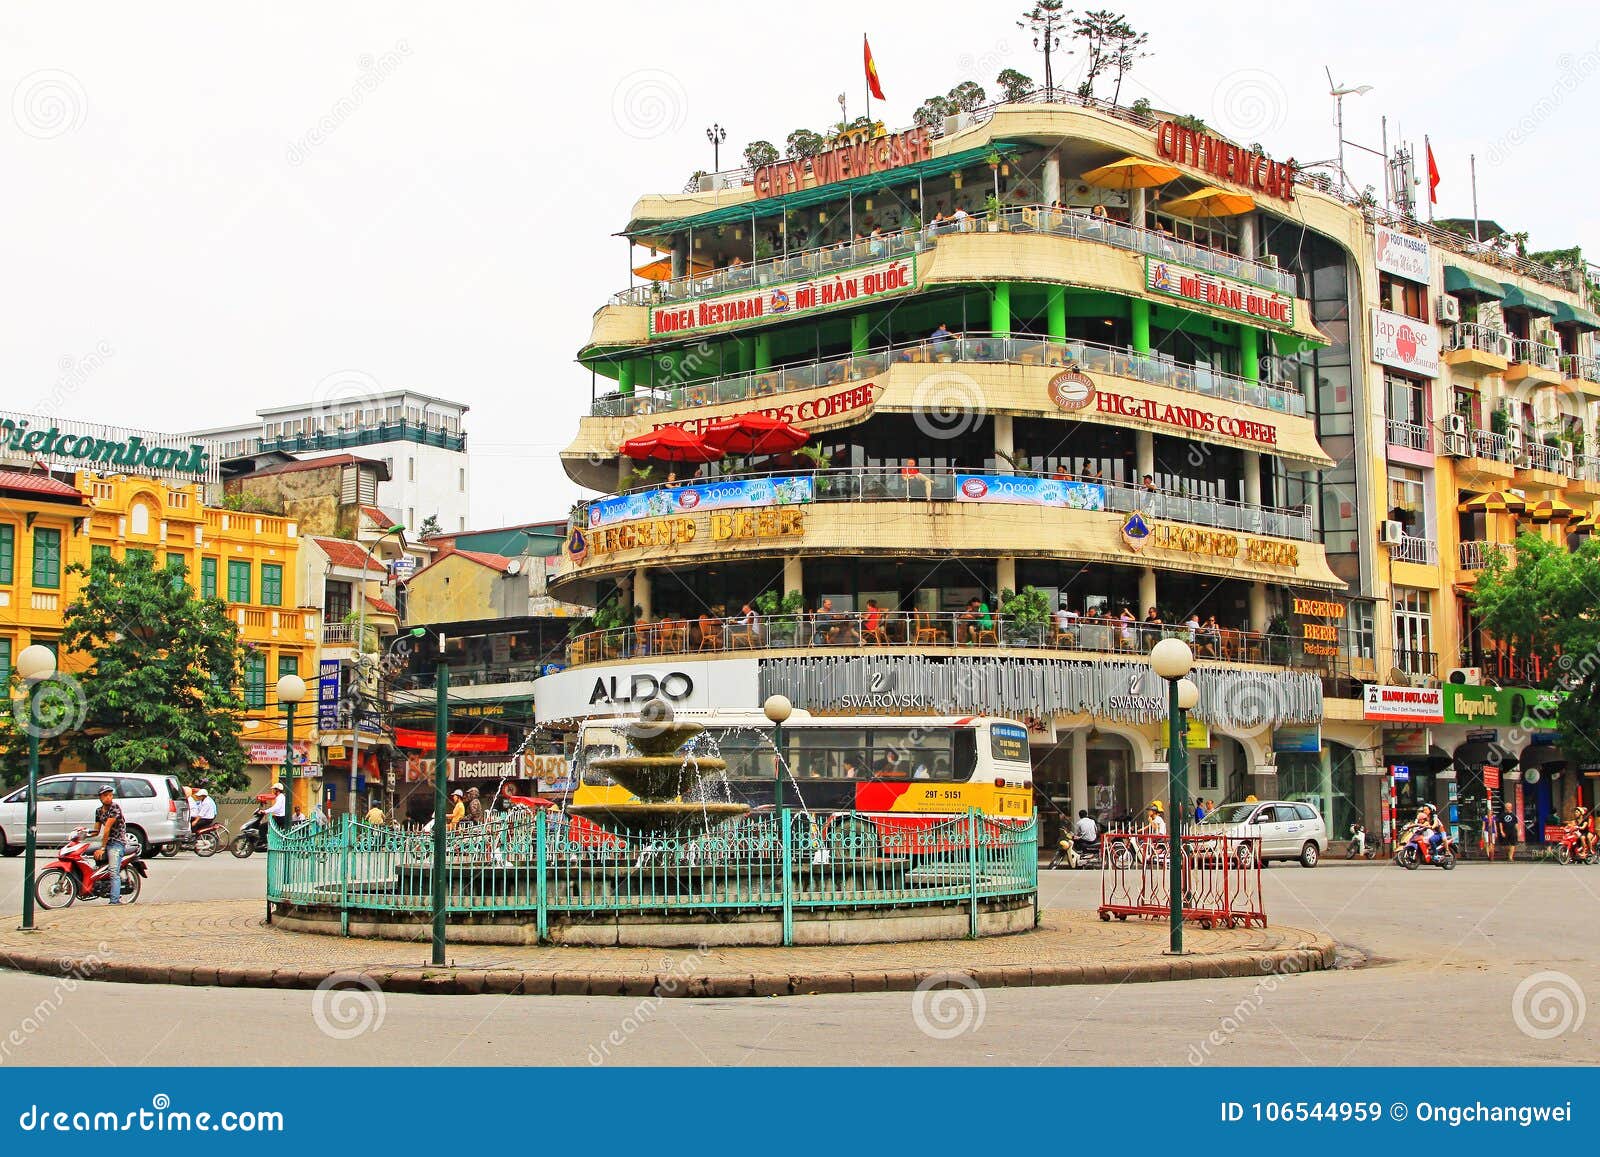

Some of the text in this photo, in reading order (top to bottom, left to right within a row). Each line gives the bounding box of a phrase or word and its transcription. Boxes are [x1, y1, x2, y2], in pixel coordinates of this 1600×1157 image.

[1157, 121, 1201, 169] CITY
[1203, 135, 1252, 188] VIEW
[753, 156, 811, 200] CITY
[810, 142, 871, 186] VIEW
[1390, 233, 1428, 255] FOOT MASSAGE
[795, 281, 817, 310] MÌ
[821, 275, 858, 304] HÀN
[863, 260, 909, 297] QUỐC
[1180, 273, 1200, 300] MÌ
[1207, 280, 1242, 310] HÀN
[798, 382, 874, 422] COFFEE
[1217, 415, 1277, 445] COFFEE
[592, 509, 805, 555] LEGEND BEER
[1293, 598, 1346, 618] LEGEND
[1303, 623, 1337, 641] BEER
[589, 671, 694, 705] ALDO
[841, 694, 926, 708] SWAROVSKI
[1110, 695, 1164, 710] SWAROVSK
[280, 768, 301, 776] AM
[458, 759, 518, 778] Restaurant
[523, 748, 568, 785] Sago
[925, 790, 938, 799] 29T
[945, 791, 961, 799] 5151
